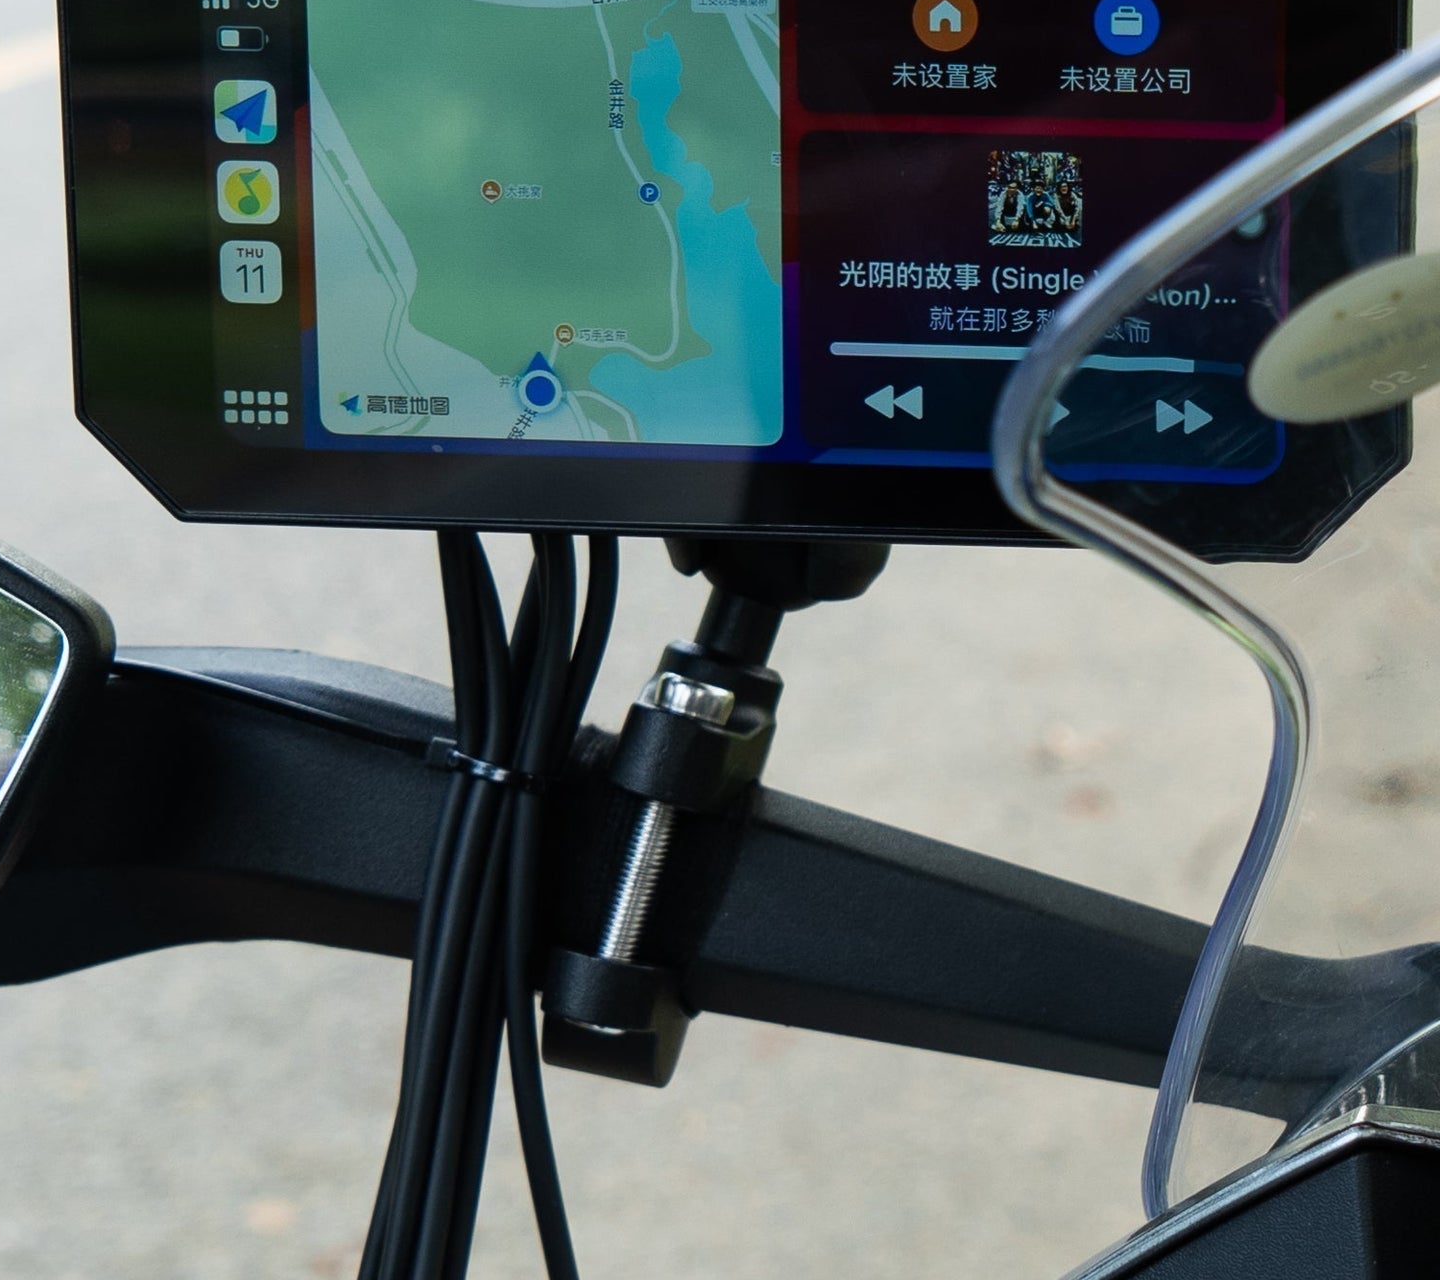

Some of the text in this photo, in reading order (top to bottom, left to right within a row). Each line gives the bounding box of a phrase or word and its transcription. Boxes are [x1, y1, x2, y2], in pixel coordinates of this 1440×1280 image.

[892, 62, 998, 91] 未设置家
[1060, 65, 1192, 95] 未设置公司
[608, 78, 626, 129] 金井路
[236, 247, 264, 259] THU
[236, 264, 265, 294] 11
[839, 260, 981, 291] 光阴的故事
[992, 265, 1086, 296] (Single
[366, 394, 450, 416] 高德地图
